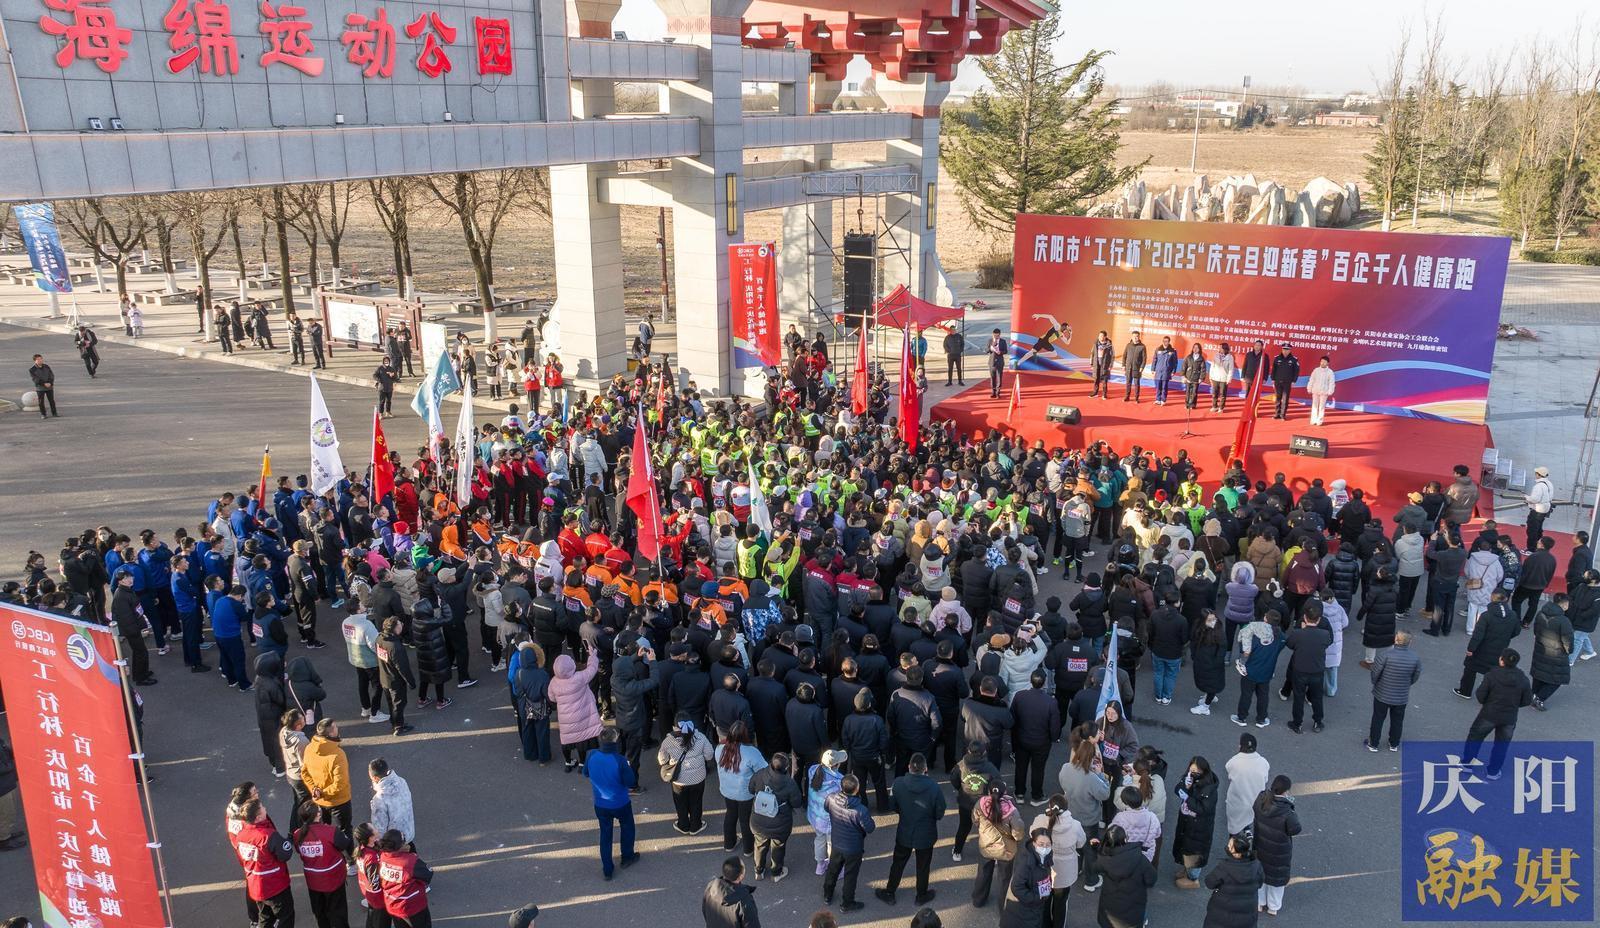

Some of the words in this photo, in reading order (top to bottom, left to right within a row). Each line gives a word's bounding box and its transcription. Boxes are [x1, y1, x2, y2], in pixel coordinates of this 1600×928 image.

[38, 0, 514, 77] 海绵运动公园
